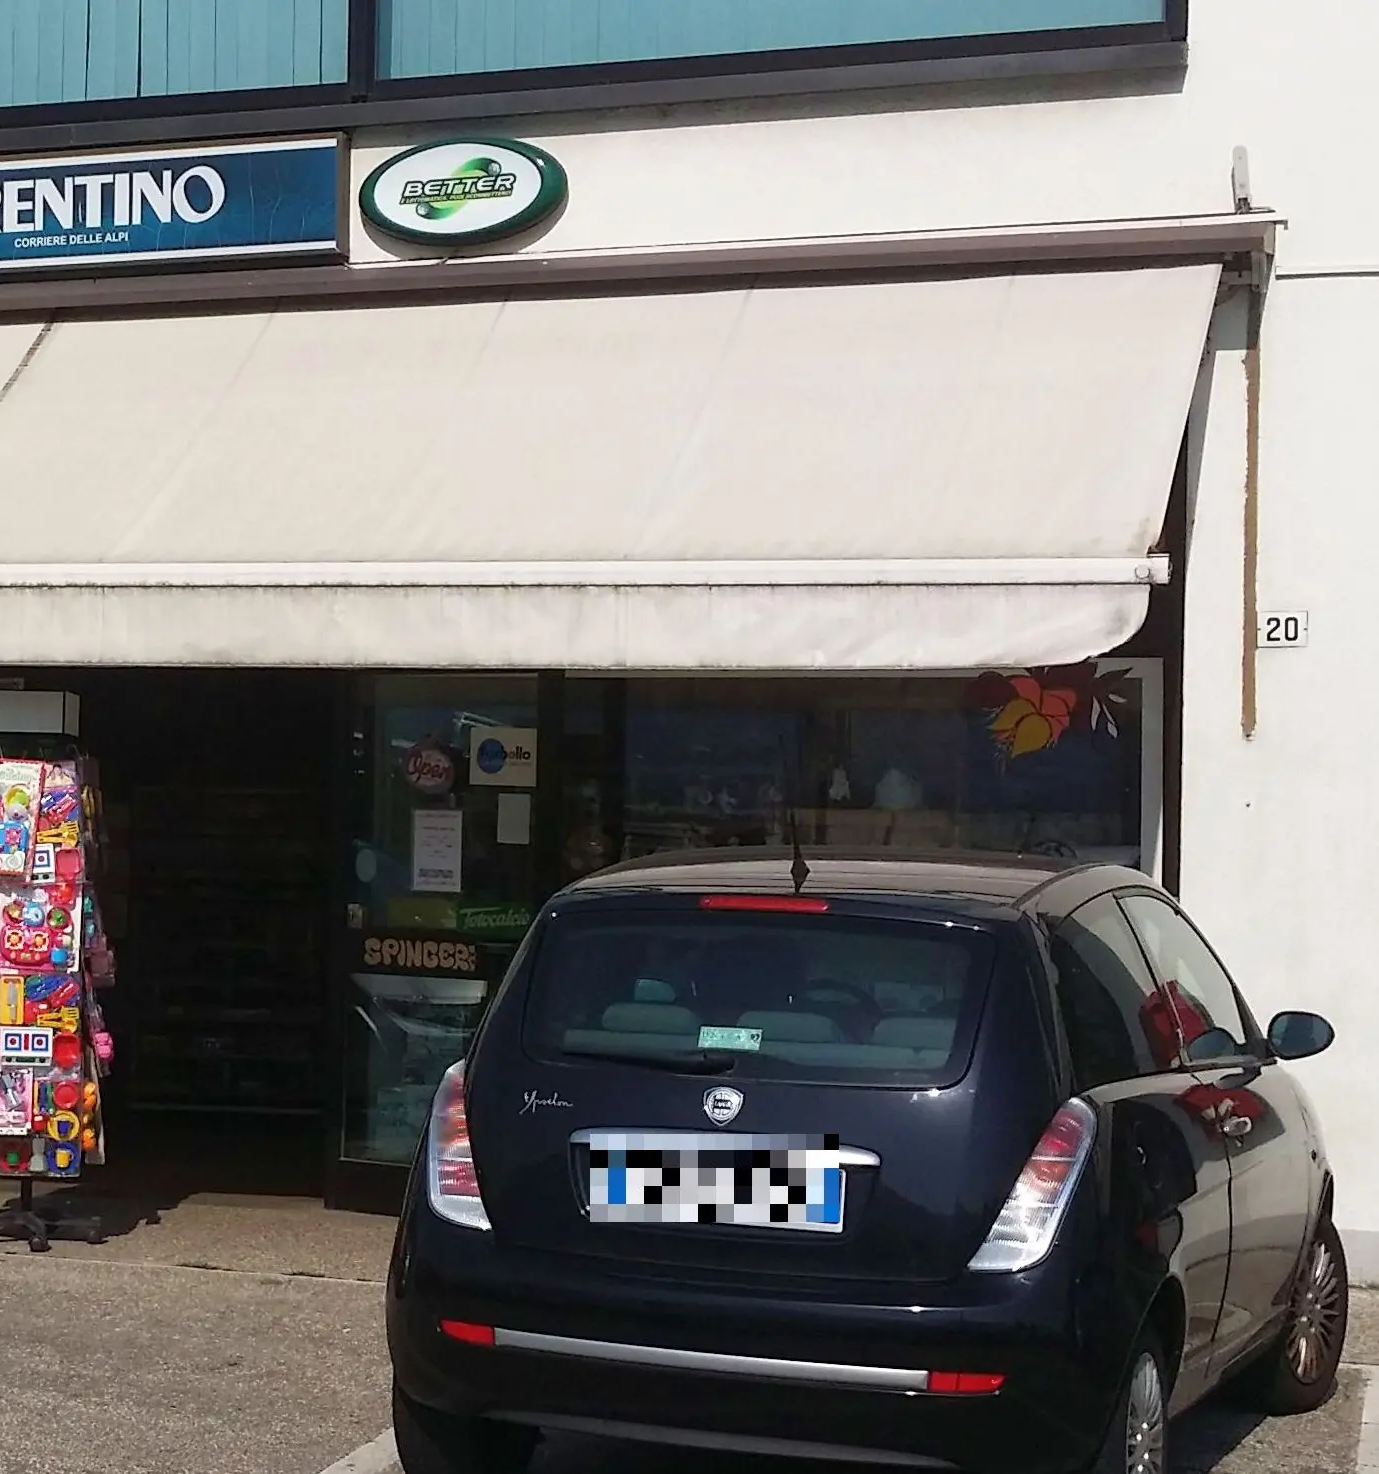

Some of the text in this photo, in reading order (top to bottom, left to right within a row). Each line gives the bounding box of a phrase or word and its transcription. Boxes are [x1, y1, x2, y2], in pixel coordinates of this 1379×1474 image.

[403, 173, 515, 197] BETTER
[14, 231, 129, 248] CORRIERE DELLE ALPI
[1267, 617, 1298, 641] 20
